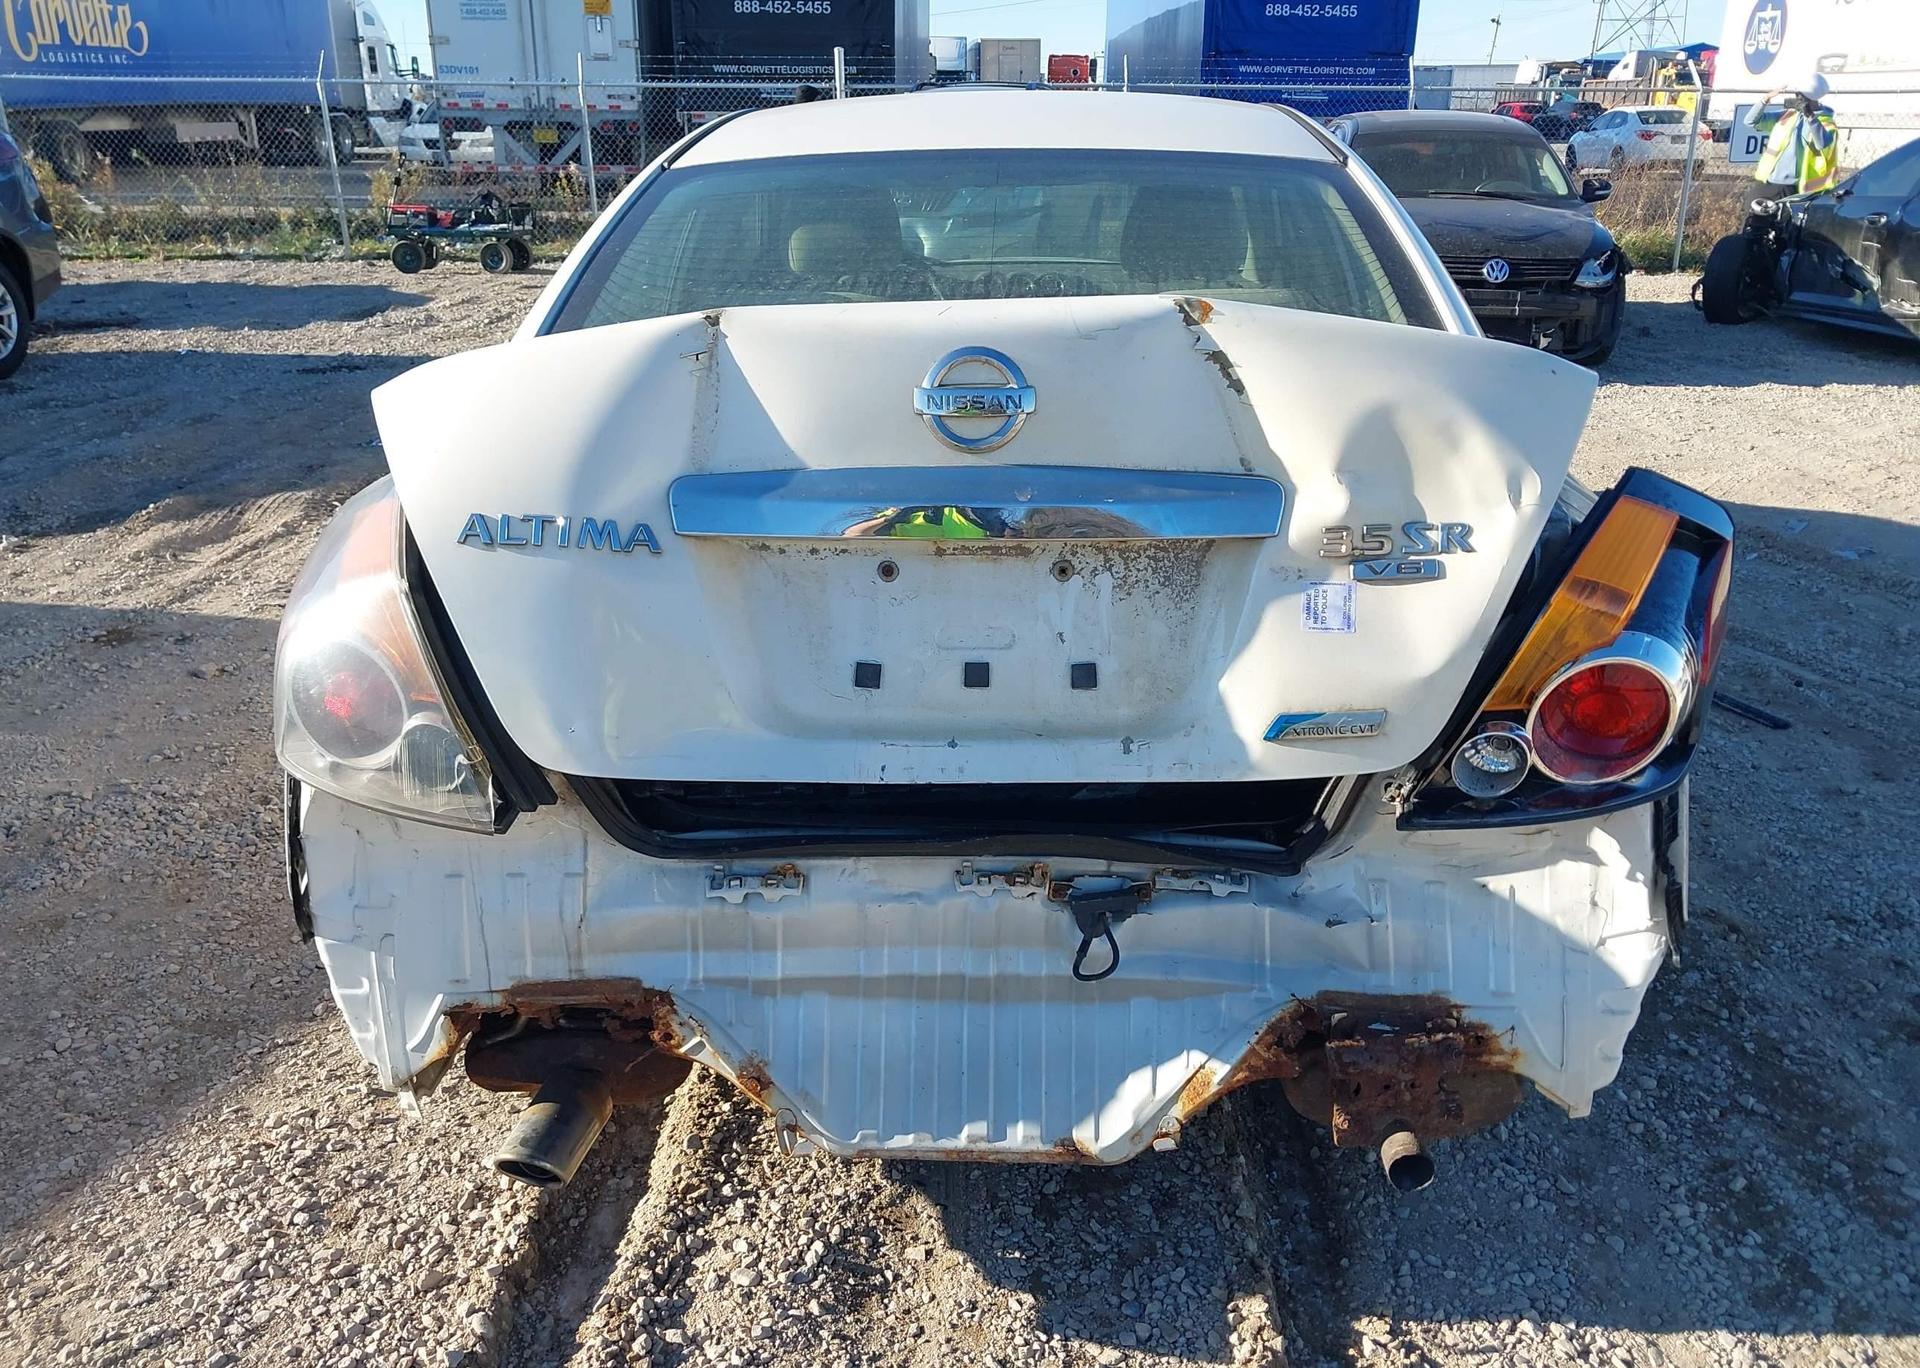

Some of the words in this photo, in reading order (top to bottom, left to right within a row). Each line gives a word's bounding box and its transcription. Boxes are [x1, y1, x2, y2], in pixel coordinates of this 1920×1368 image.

[734, 0, 831, 14] 888-452-5455
[1265, 3, 1358, 17] 888-452-5455
[41, 52, 104, 64] LOGISTICS
[439, 64, 480, 74] 53DV101
[713, 64, 857, 74] WWW.CORVETTELOGISTICSOM
[1239, 65, 1376, 75] WWW.CORVETTELOGISTICS.COM
[926, 393, 1025, 412] NISSAN
[456, 512, 663, 554] ALTIMA
[1319, 523, 1394, 558] 3.5
[1402, 521, 1477, 556] SR
[1364, 560, 1425, 576] V6
[1312, 588, 1320, 625] REPORTED
[1321, 588, 1329, 614] POLICE
[1320, 615, 1328, 625] TO
[1292, 724, 1348, 737] XTRONIC
[1350, 723, 1376, 735] CVT
